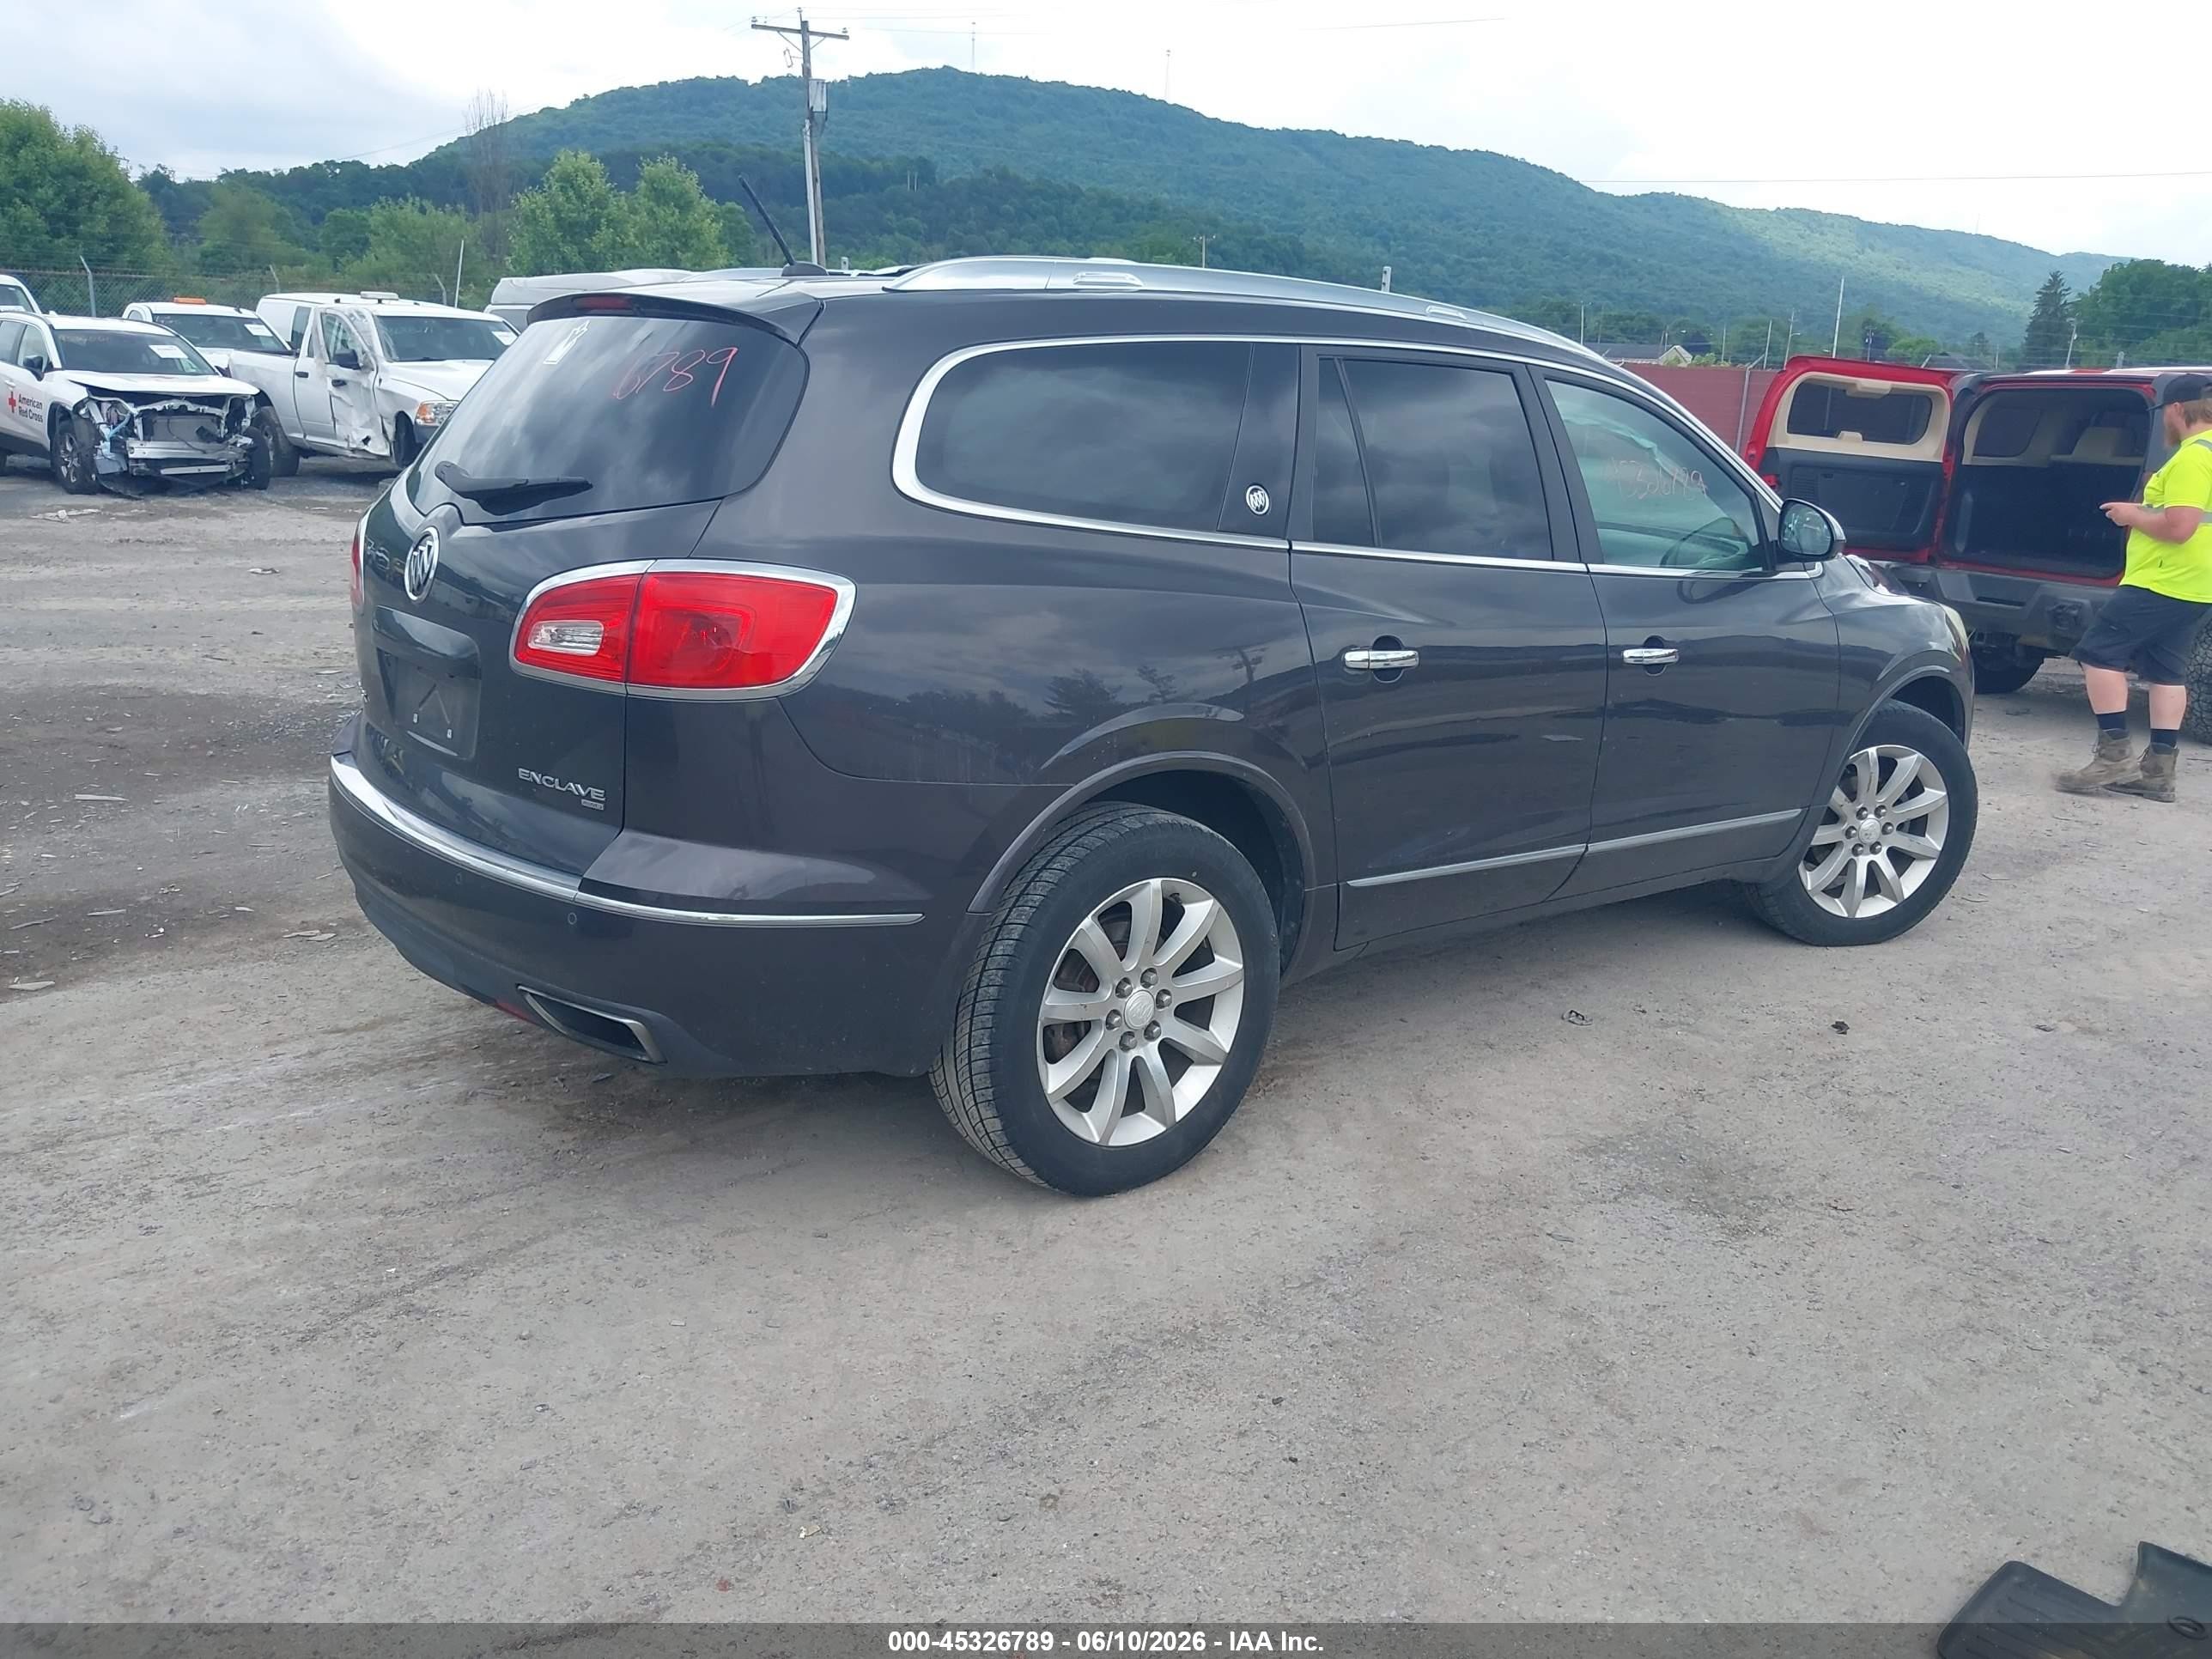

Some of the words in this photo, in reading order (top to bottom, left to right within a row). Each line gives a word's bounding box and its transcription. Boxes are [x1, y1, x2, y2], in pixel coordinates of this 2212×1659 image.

[613, 347, 738, 407] 6789
[18, 393, 43, 410] American
[18, 405, 28, 418] Red
[28, 409, 44, 422] Cross
[518, 768, 606, 801] ENCLAVE
